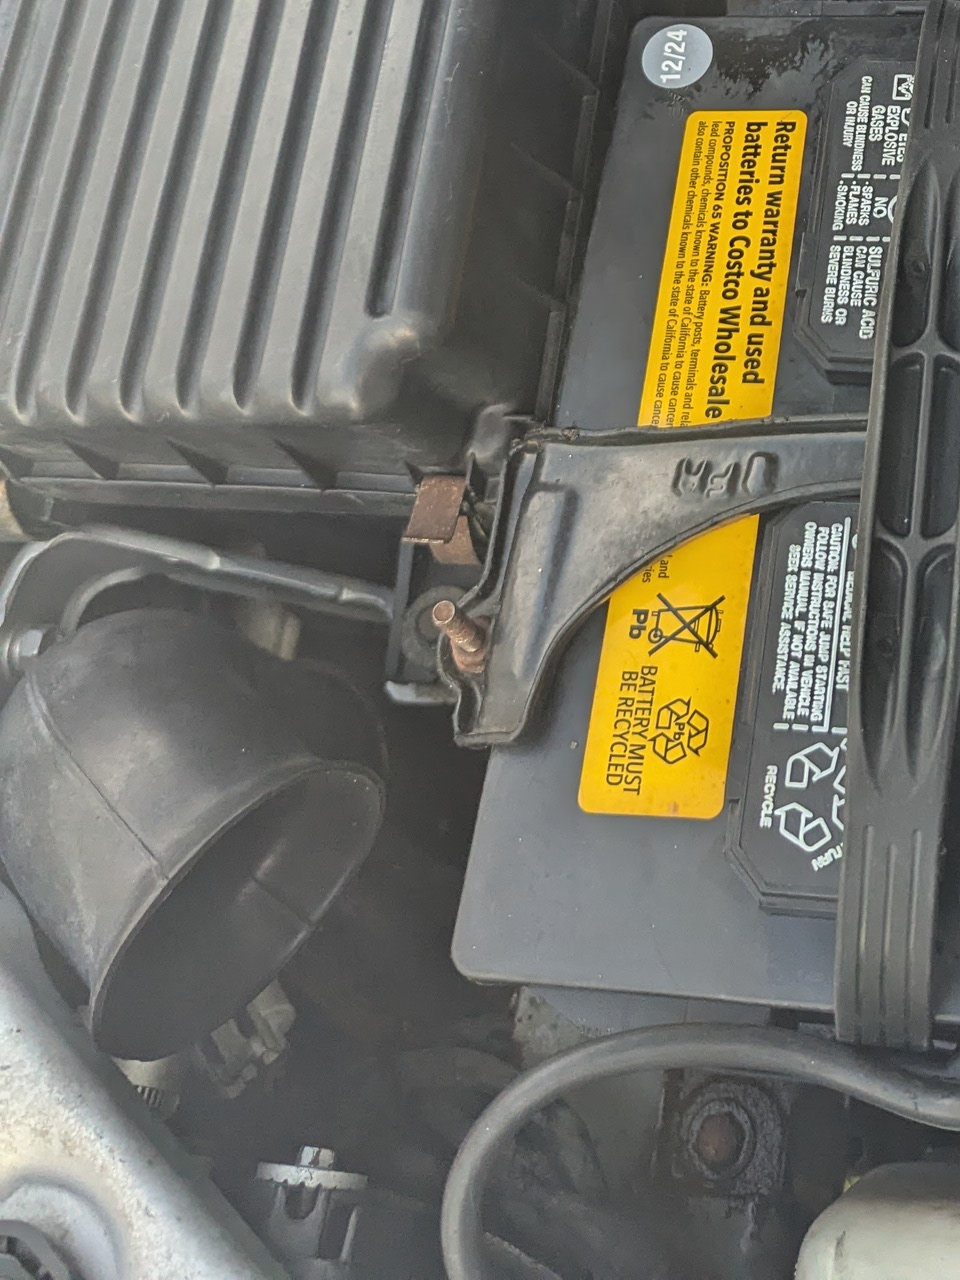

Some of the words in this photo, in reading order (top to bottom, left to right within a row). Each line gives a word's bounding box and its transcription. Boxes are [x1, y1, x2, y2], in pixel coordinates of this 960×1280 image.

[660, 29, 687, 84] 12/24
[861, 76, 872, 93] CAN
[846, 101, 858, 114] OR
[857, 95, 870, 123] CAUSE
[697, 121, 708, 136] also
[710, 121, 722, 137] lead
[843, 116, 855, 147] INJURY
[868, 105, 885, 141] GASES
[881, 105, 901, 166] EXPLOSIVE
[692, 137, 704, 166] contain
[701, 138, 717, 186] compounds,
[714, 121, 735, 201] PROPOSITION
[768, 121, 796, 185] Return
[851, 124, 867, 171] BLINDNESS
[689, 167, 700, 189] other
[735, 122, 768, 205] batteries
[682, 190, 697, 230] chemicals
[696, 188, 712, 228] chemicals
[711, 204, 722, 219] 65
[732, 210, 753, 230] to
[873, 197, 888, 218] NO
[678, 231, 692, 258] known
[692, 230, 706, 257] known
[750, 190, 782, 282] warranty
[676, 260, 686, 269] to
[690, 258, 700, 267] to
[701, 222, 720, 286] WARNING:
[722, 236, 751, 300] Costco
[826, 245, 841, 285] SEVERE
[855, 246, 867, 267] CAN
[673, 270, 685, 284] the
[687, 269, 699, 283] the
[837, 246, 854, 304] BLINDNESS
[850, 271, 864, 307] CAUSE
[863, 246, 883, 306] SULFURIC
[669, 286, 681, 306] state
[684, 284, 695, 305] state
[693, 290, 710, 320] Battery
[749, 287, 772, 326] and
[821, 287, 836, 323] BURNS
[668, 308, 679, 317] of
[683, 306, 693, 315] of
[835, 308, 847, 325] OR
[859, 309, 875, 339] ACID
[661, 319, 677, 360] California
[676, 317, 692, 358] California
[690, 321, 703, 347] posts,
[660, 362, 670, 371] to
[674, 360, 685, 369] to
[685, 349, 700, 390] terminals
[705, 305, 741, 418] Wholesale
[742, 333, 765, 384] used
[655, 373, 667, 398] cause
[670, 371, 681, 396] cause
[651, 399, 662, 425] cance
[682, 392, 694, 409] and
[679, 411, 692, 428] rela
[787, 544, 801, 572] SEEK
[801, 522, 817, 567] OWNERS
[814, 527, 829, 570] FOLLOW
[827, 523, 843, 572] CAUTION:
[659, 559, 670, 579] and
[781, 574, 797, 620] SERVICE
[824, 575, 837, 598] FOR
[629, 608, 650, 640] Pb
[794, 620, 805, 632] IF
[804, 573, 824, 651] INSTRUCTIONS
[820, 600, 835, 628] SAFE
[772, 622, 791, 693] ASSISTANCE.
[791, 634, 803, 658] NOT
[803, 654, 815, 667] IN
[818, 631, 831, 662] JUMP
[620, 670, 639, 692] BE
[782, 661, 800, 720] AVAILABLE
[836, 660, 850, 692] FAST
[632, 664, 658, 740] BATTERY
[797, 670, 813, 716] VEHICLE
[810, 665, 828, 721] STARTING
[606, 696, 634, 786] RECYCLED
[673, 721, 686, 742] Pb
[624, 743, 646, 795] MUST
[760, 764, 778, 829] RECYCLE
